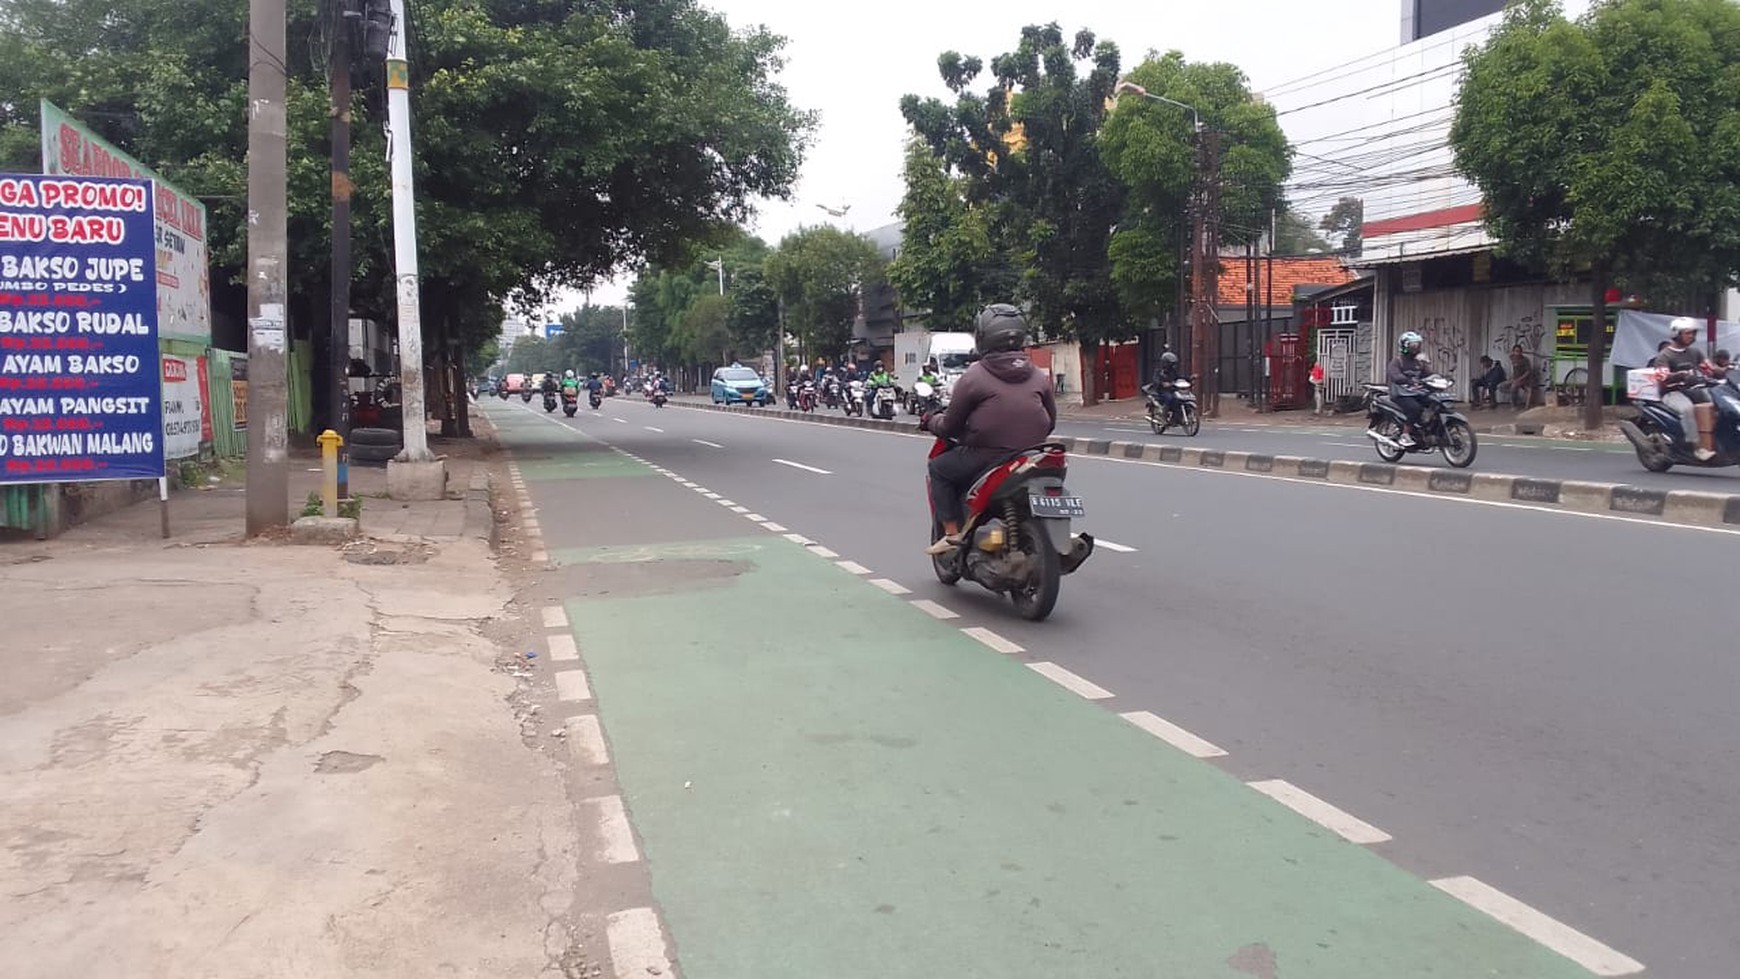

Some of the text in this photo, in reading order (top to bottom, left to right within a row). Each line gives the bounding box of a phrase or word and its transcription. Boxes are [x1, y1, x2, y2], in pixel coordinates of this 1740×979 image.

[0, 181, 36, 206] GA
[41, 182, 145, 210] PROMO!
[49, 217, 123, 243] BARU
[1, 255, 79, 279] BAKSO
[85, 257, 144, 281] JUPE
[0, 311, 149, 335] BAKSO RUDAL
[2, 354, 140, 374] AYAM BAKSO
[0, 397, 54, 415] AYAM
[60, 397, 149, 414] PANGSIT
[12, 432, 82, 456] BAKWAN
[87, 432, 154, 454] MALANG
